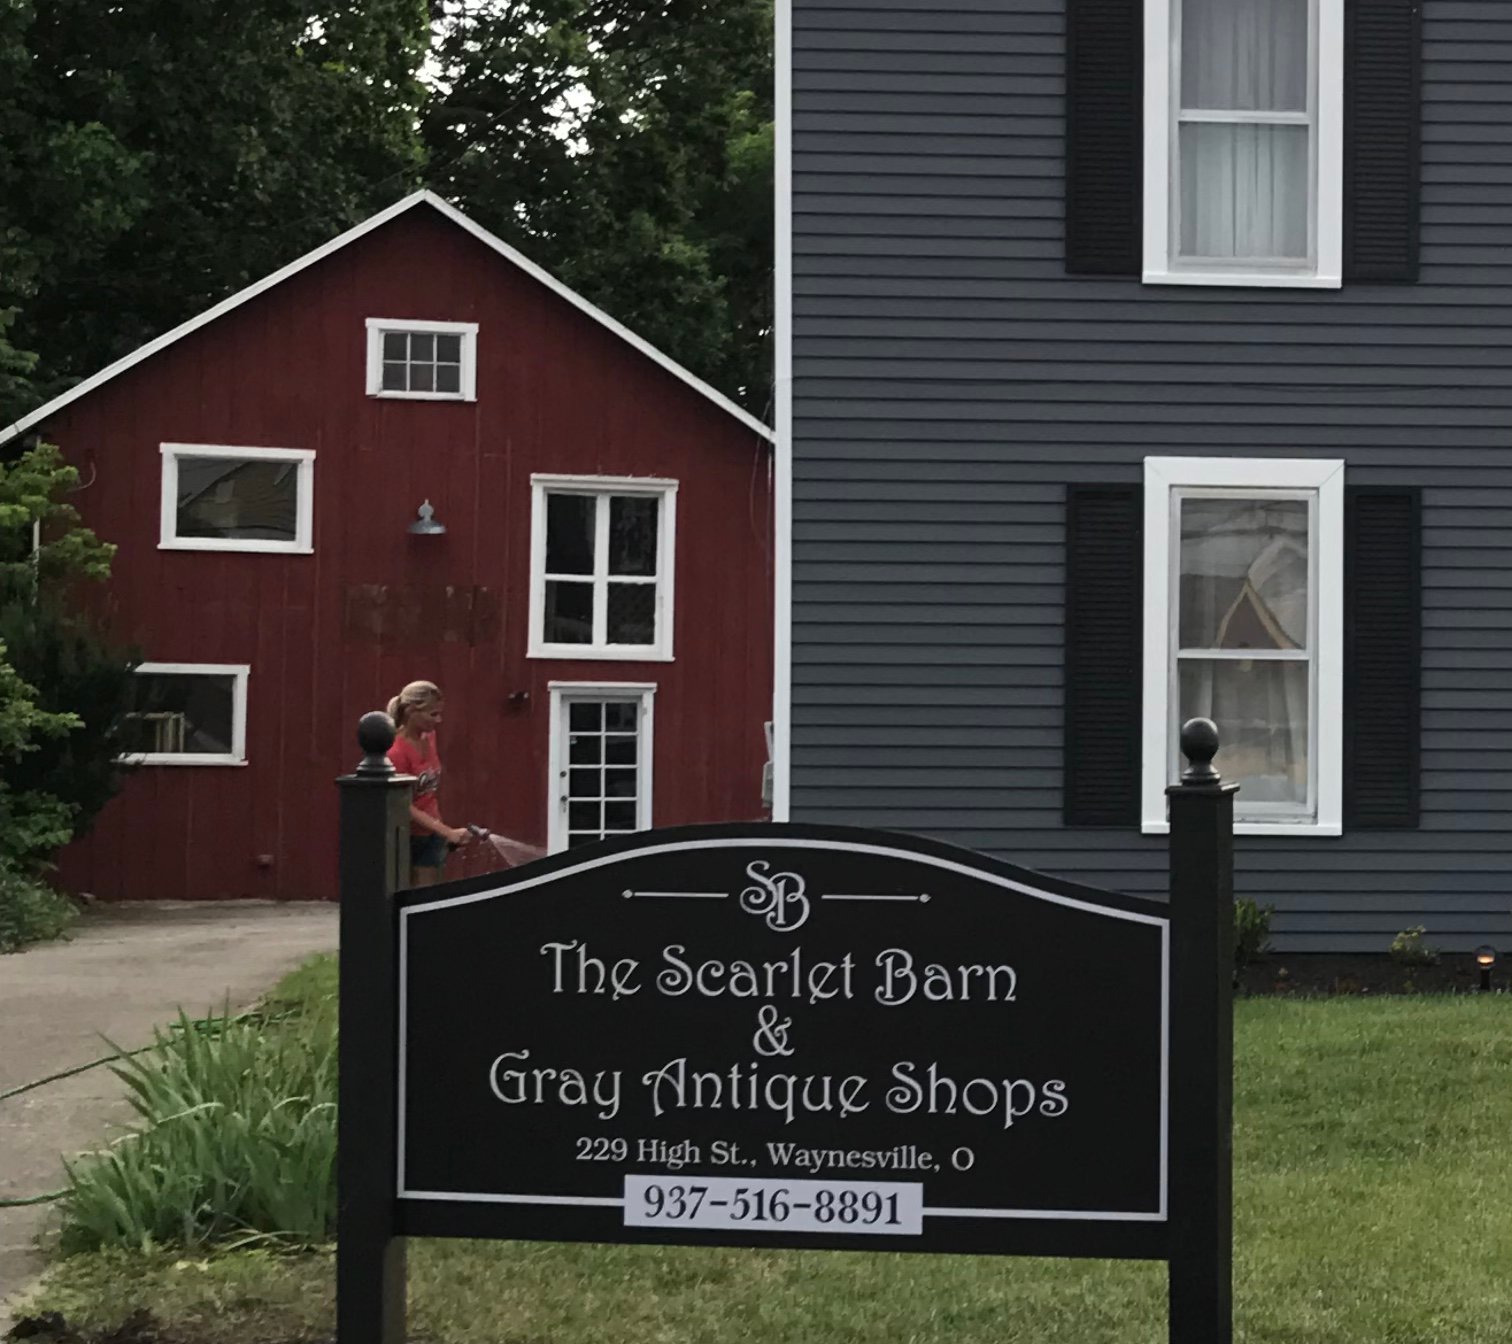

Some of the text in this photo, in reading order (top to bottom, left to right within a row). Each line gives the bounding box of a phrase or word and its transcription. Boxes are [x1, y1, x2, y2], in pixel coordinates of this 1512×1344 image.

[539, 939, 1017, 1006] The Scarlet Barn
[752, 1004, 795, 1057] &
[489, 1049, 1069, 1130] Gray Antique Shops
[575, 1136, 975, 1174] 229 High St., Waynesville, O
[643, 1184, 902, 1225] 937-516-8891
